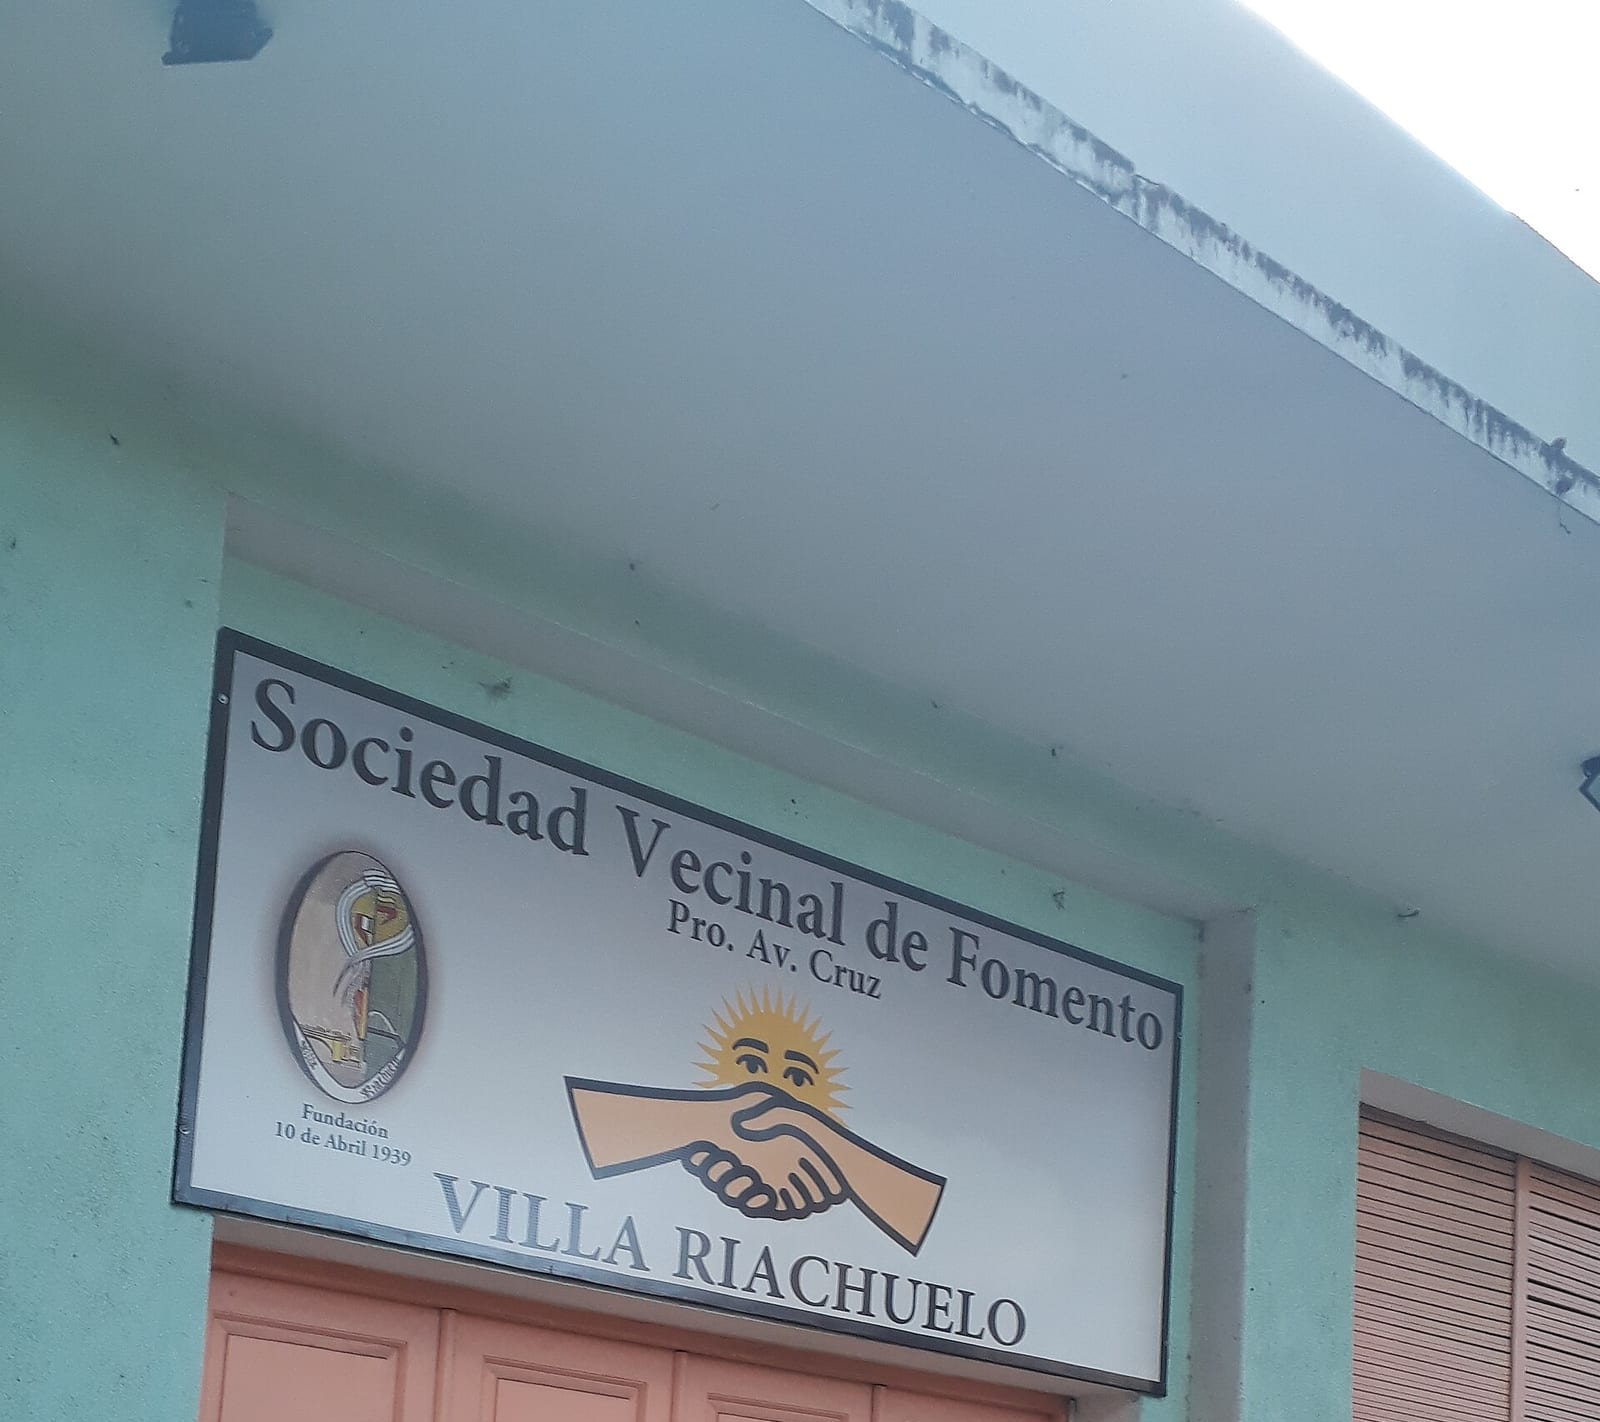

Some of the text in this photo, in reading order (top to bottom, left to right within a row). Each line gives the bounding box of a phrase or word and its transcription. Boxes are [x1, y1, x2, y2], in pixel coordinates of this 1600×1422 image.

[250, 677, 1164, 1051] Sociedad Vecinal de Fomento
[666, 898, 882, 1000] Pro. Av. Cruz
[275, 1121, 412, 1167] 10 de Abril 1939
[301, 1103, 389, 1139] Fundación
[433, 1172, 1027, 1346] VILLA RIACHUELO
